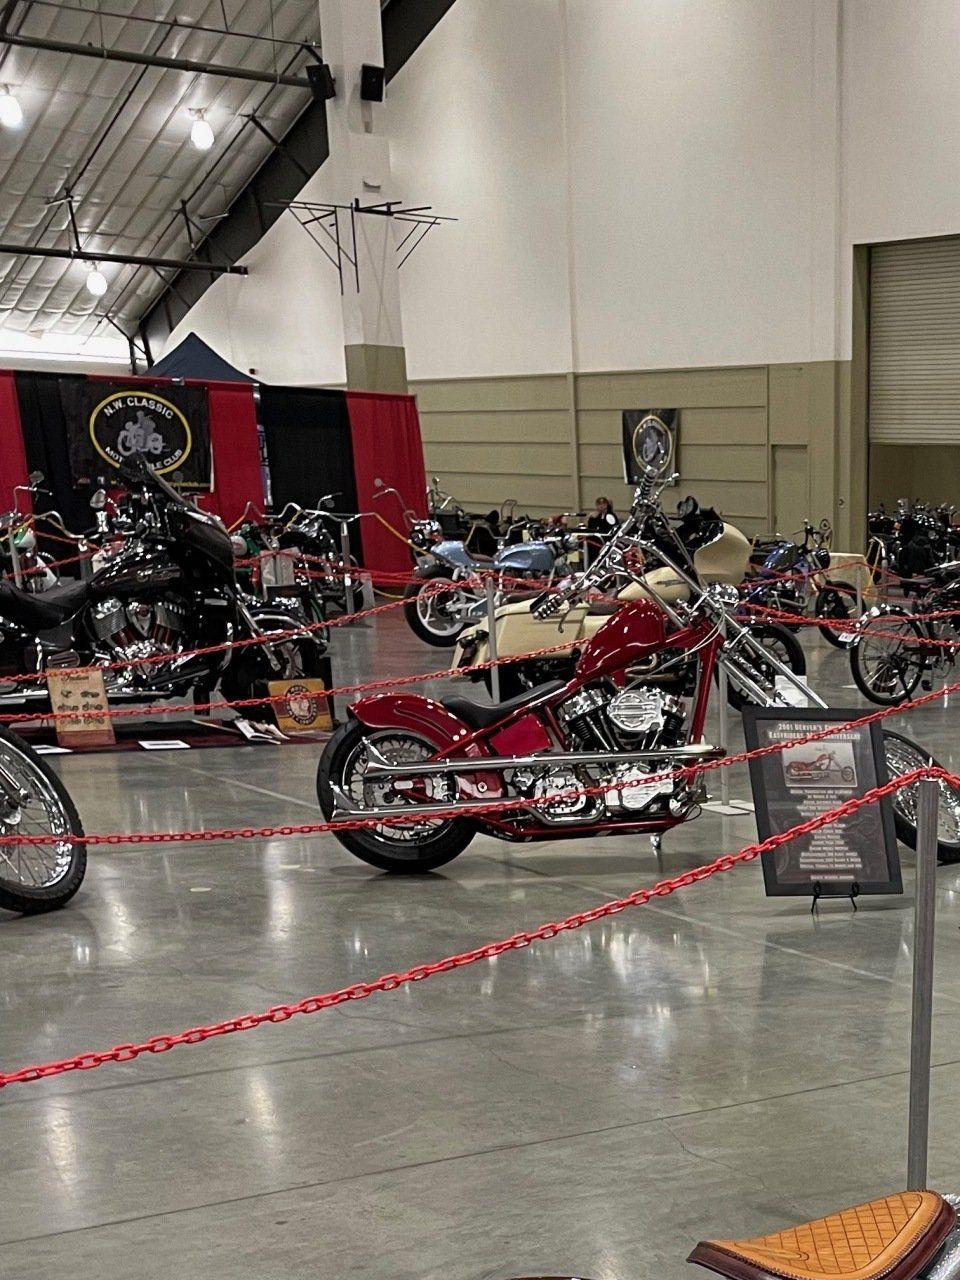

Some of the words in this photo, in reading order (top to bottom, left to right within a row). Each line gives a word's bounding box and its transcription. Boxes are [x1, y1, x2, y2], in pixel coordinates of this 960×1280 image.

[103, 399, 126, 417] N.W.
[126, 397, 174, 419] CLASSIC
[105, 446, 163, 470] MOTLE
[163, 449, 183, 466] CLUB
